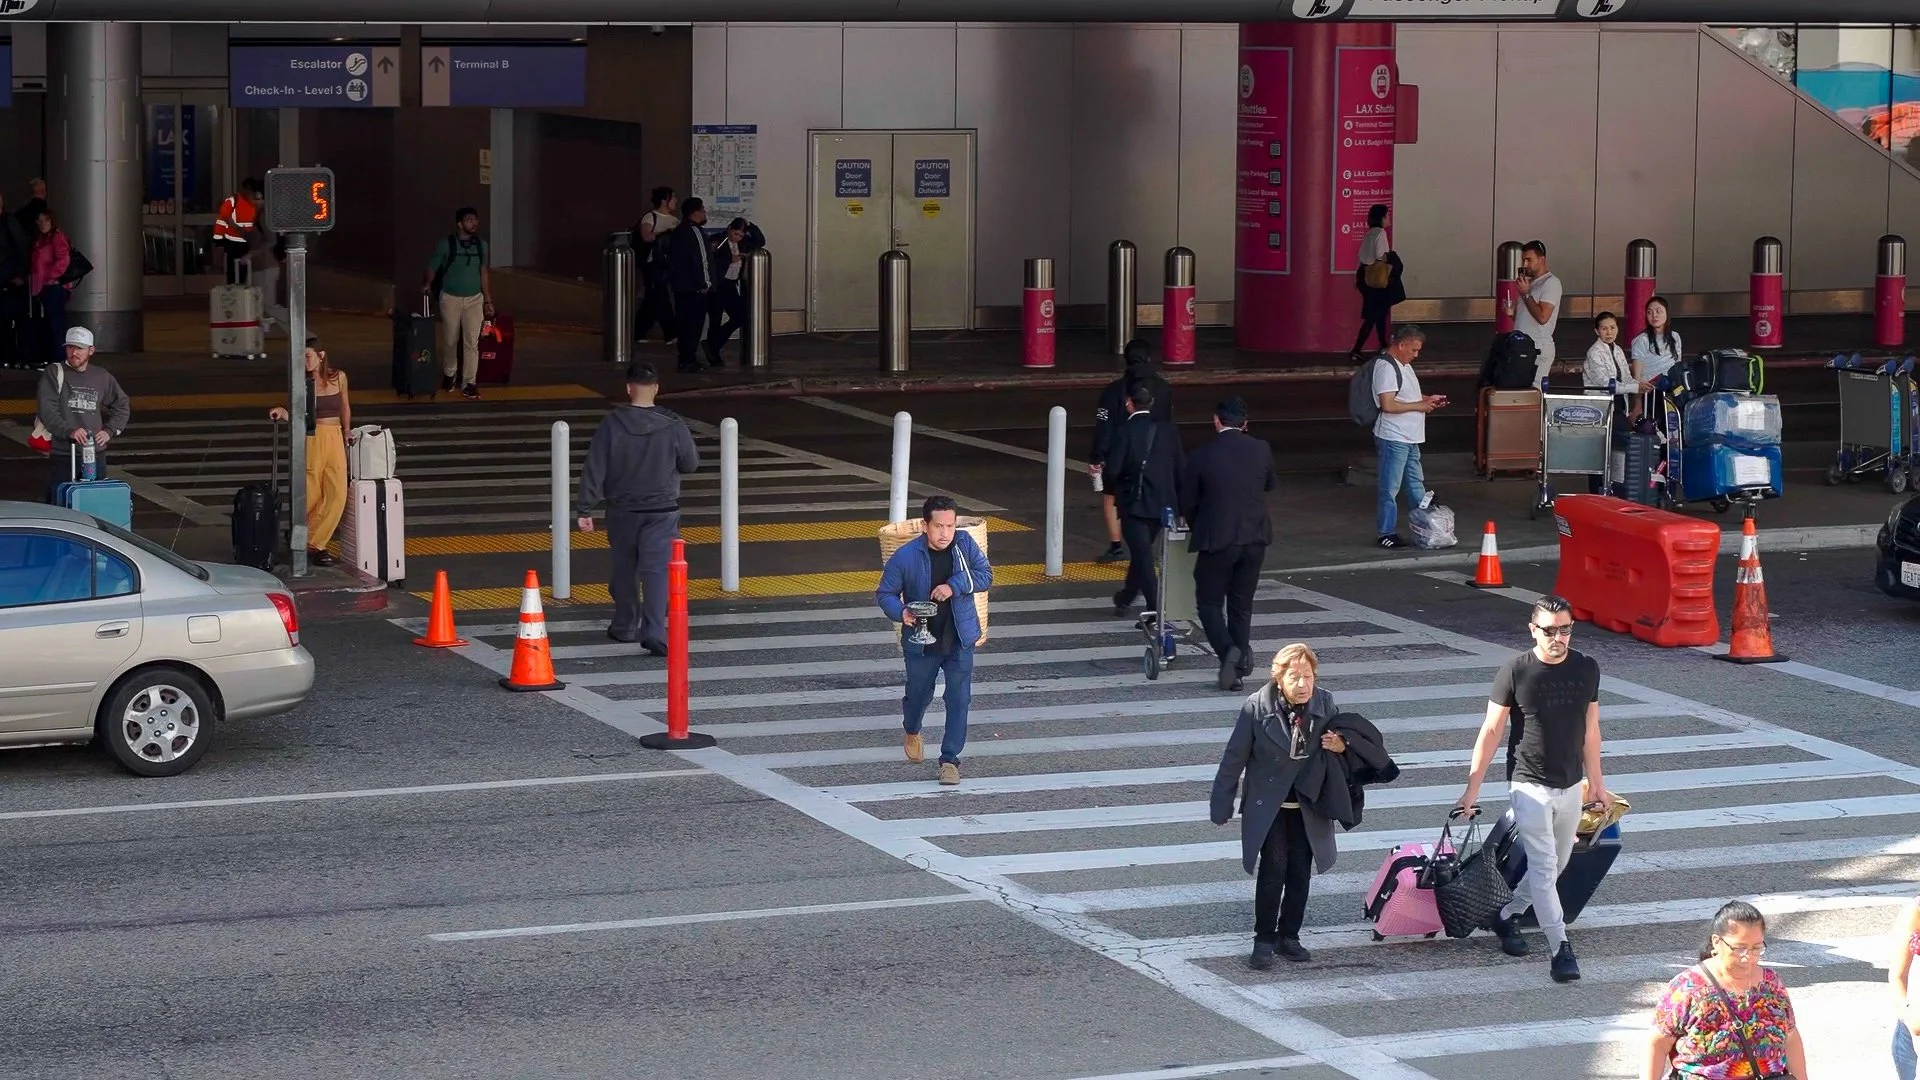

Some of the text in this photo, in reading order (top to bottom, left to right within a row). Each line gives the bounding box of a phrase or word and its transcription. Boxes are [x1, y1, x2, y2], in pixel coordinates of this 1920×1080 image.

[290, 59, 343, 69] Escalator
[453, 60, 510, 69] Terminal B
[244, 85, 295, 95] Check-In
[304, 85, 334, 95] Level
[335, 86, 343, 95] 3
[1356, 104, 1373, 114] LAX
[312, 182, 328, 220] 5
